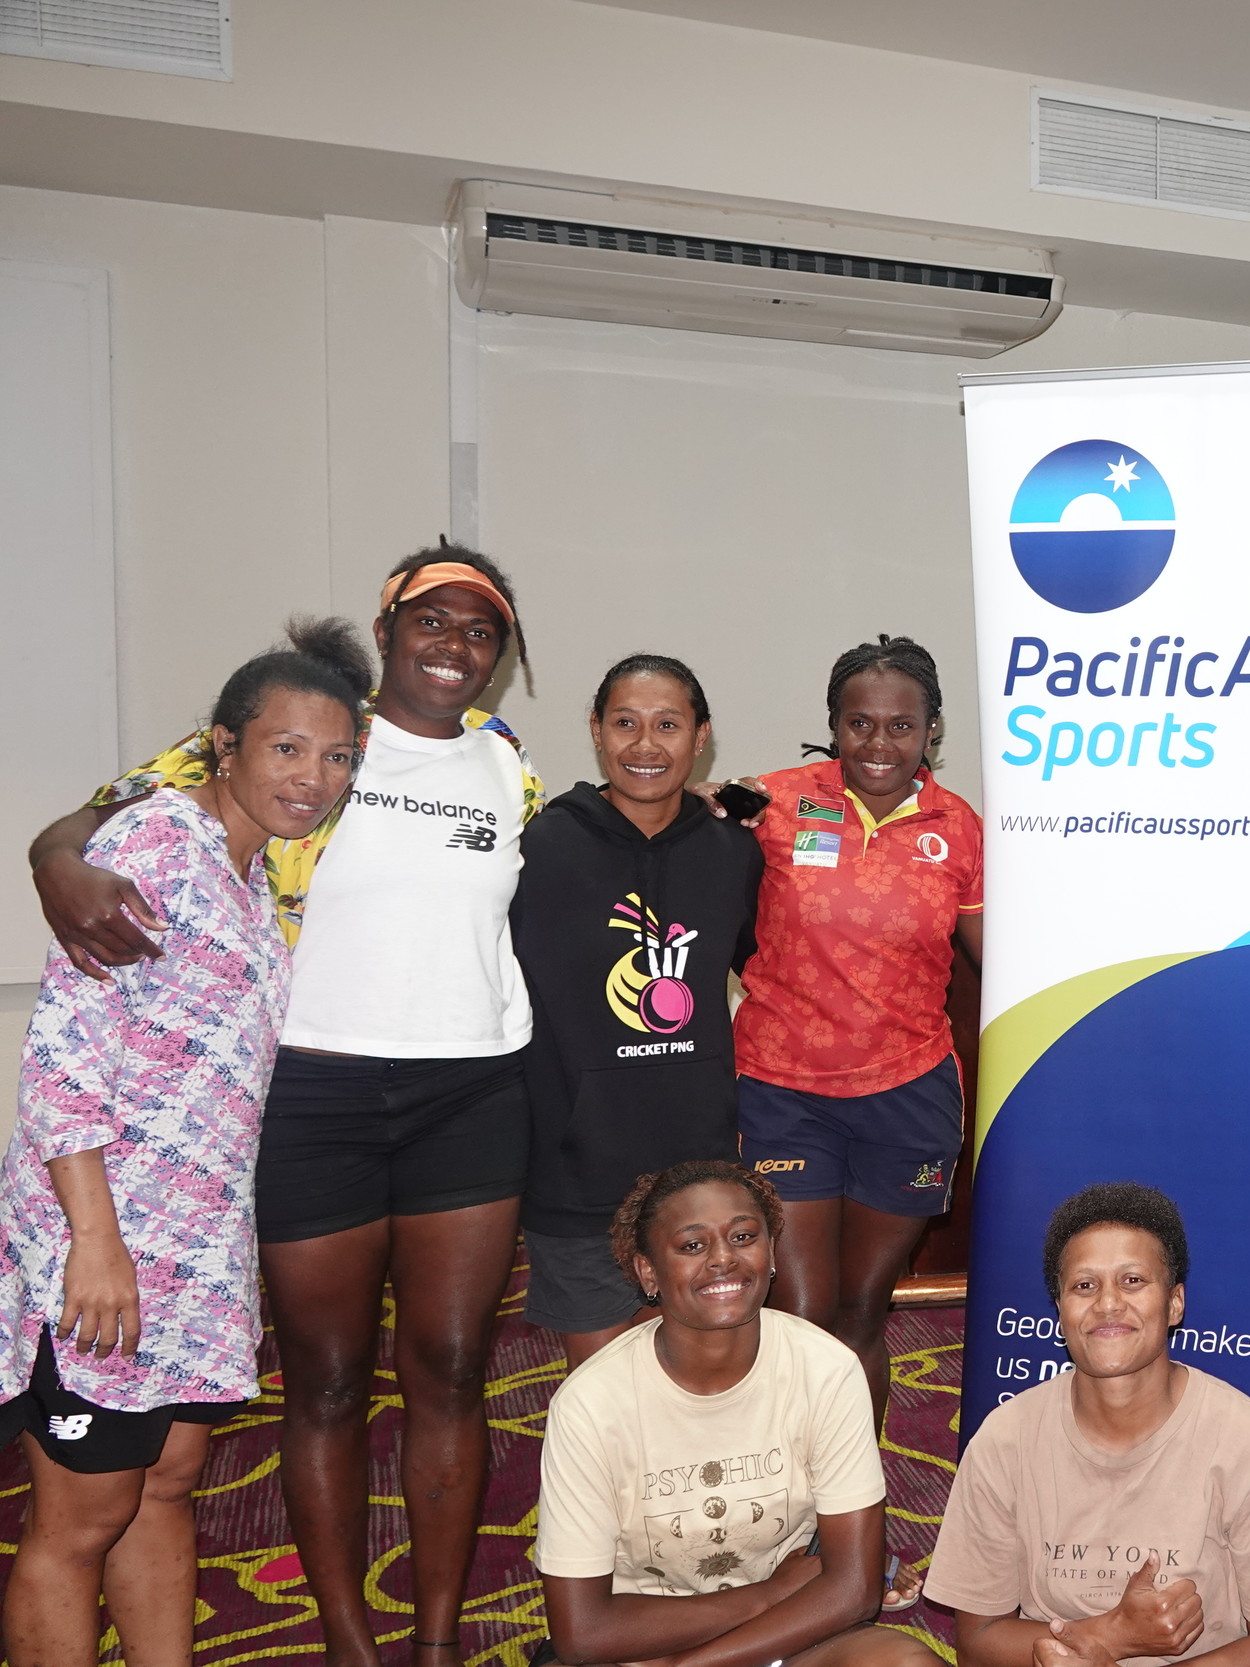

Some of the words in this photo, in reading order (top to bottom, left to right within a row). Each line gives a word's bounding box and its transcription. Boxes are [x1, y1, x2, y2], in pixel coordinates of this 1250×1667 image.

[1001, 704, 1218, 781] Sports
[346, 789, 399, 809] new
[403, 795, 497, 826] balance
[616, 1042, 669, 1058] CRICKET
[670, 1040, 695, 1053] PNG
[996, 1307, 1067, 1347] Geog
[996, 1356, 1031, 1380] us
[1044, 1542, 1089, 1561] NEW
[1097, 1569, 1117, 1580] OF
